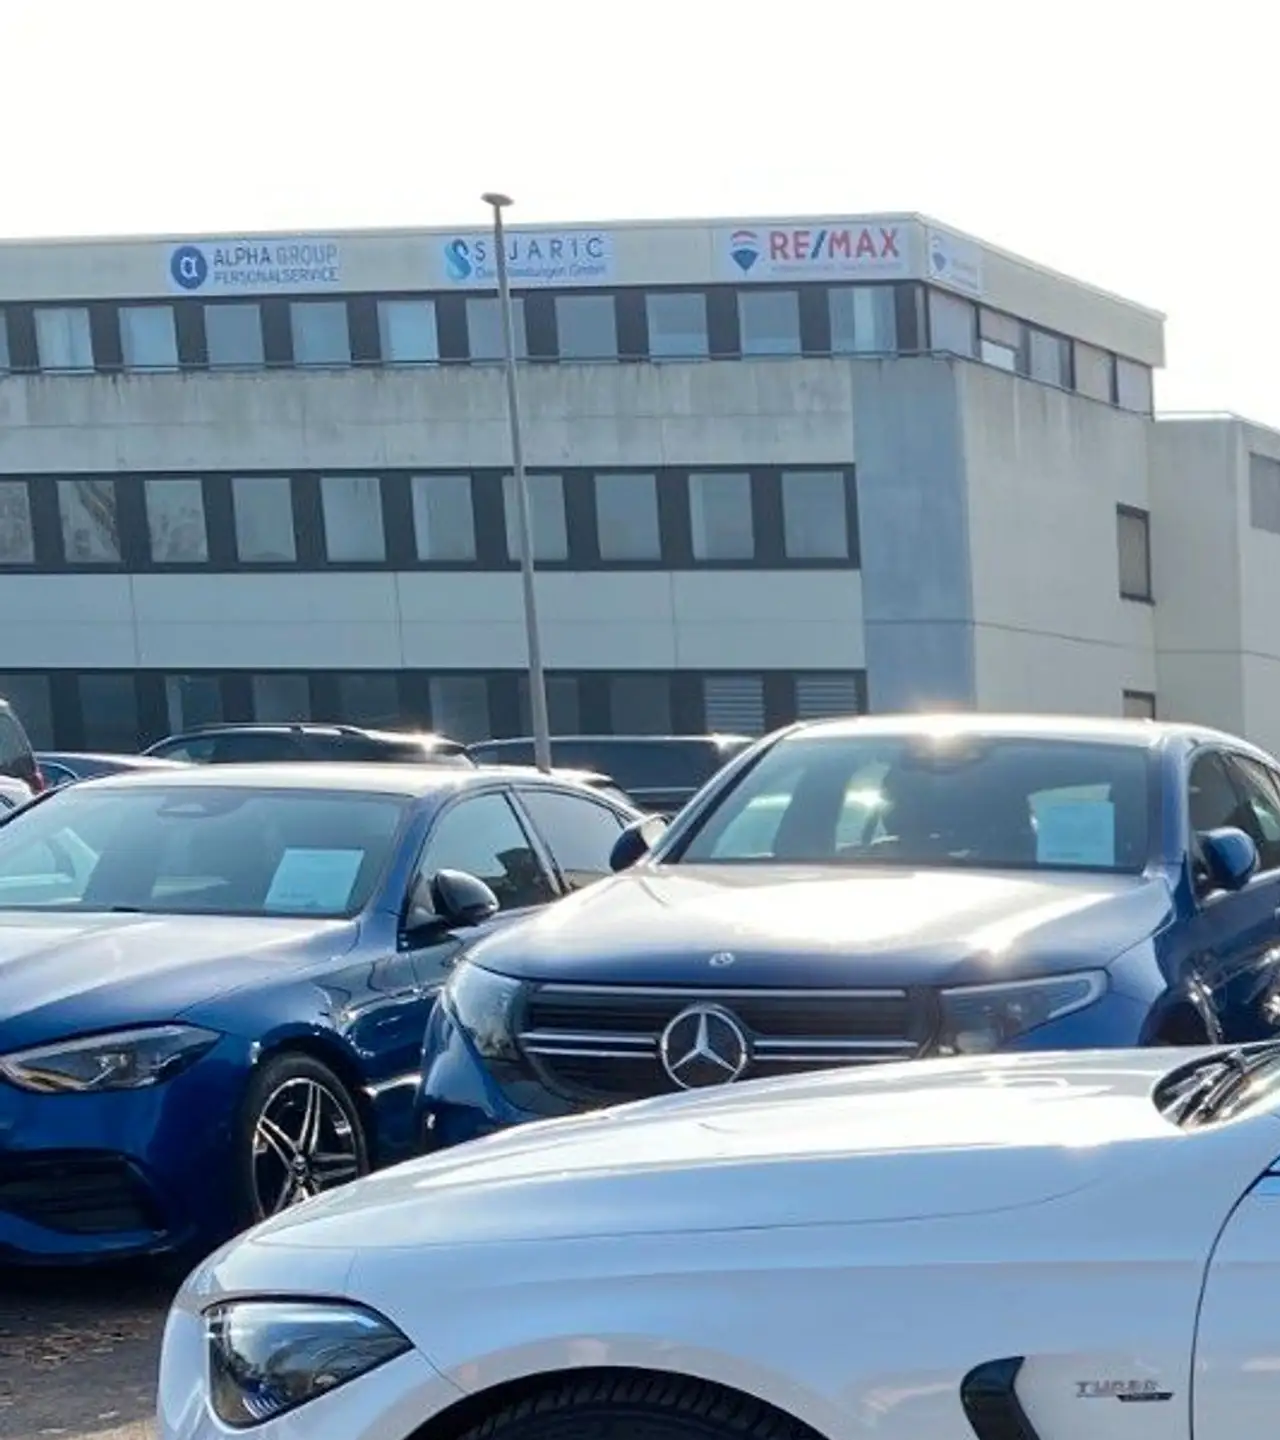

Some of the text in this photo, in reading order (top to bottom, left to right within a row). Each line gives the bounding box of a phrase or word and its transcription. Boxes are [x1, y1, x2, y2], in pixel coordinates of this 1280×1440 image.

[213, 243, 338, 267] ALPHA GROUP
[474, 237, 604, 262] SJARIC
[768, 227, 899, 260] RE/MAX
